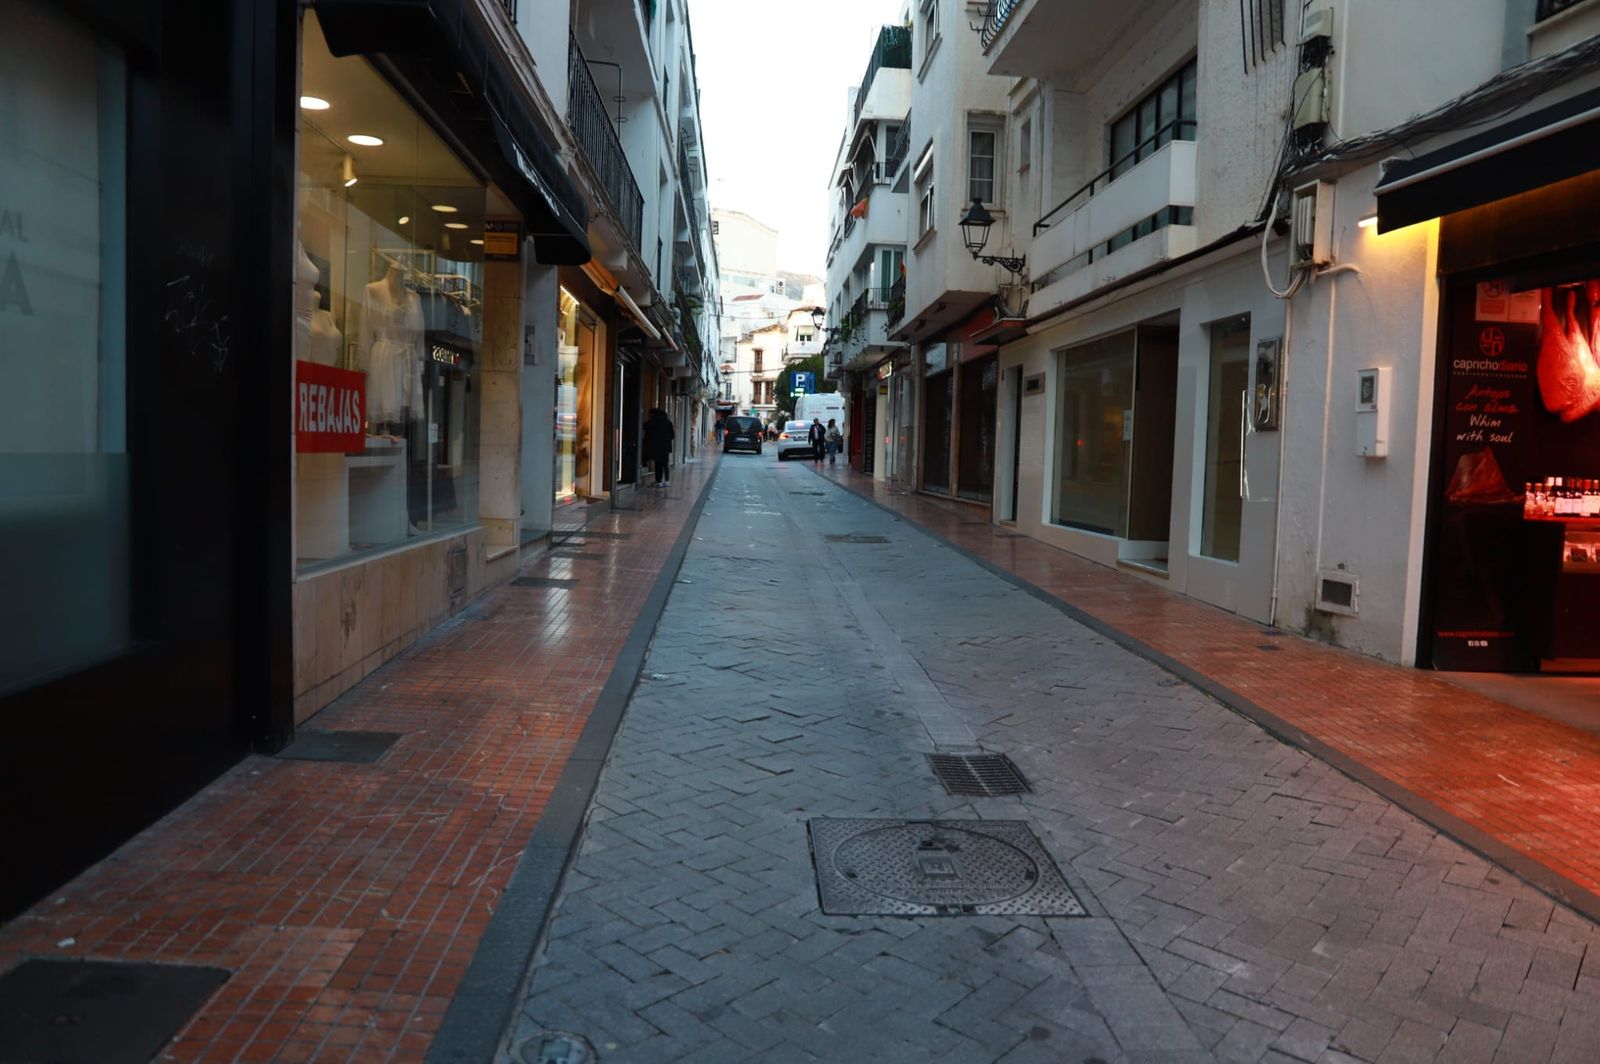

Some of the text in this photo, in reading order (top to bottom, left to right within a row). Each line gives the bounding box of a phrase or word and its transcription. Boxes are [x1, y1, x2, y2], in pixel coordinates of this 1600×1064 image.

[1453, 358, 1528, 372] caprichodiario
[795, 373, 806, 387] P
[299, 382, 361, 434] REBAJAS
[1469, 413, 1502, 428] Whim
[1456, 429, 1514, 443] with soul
